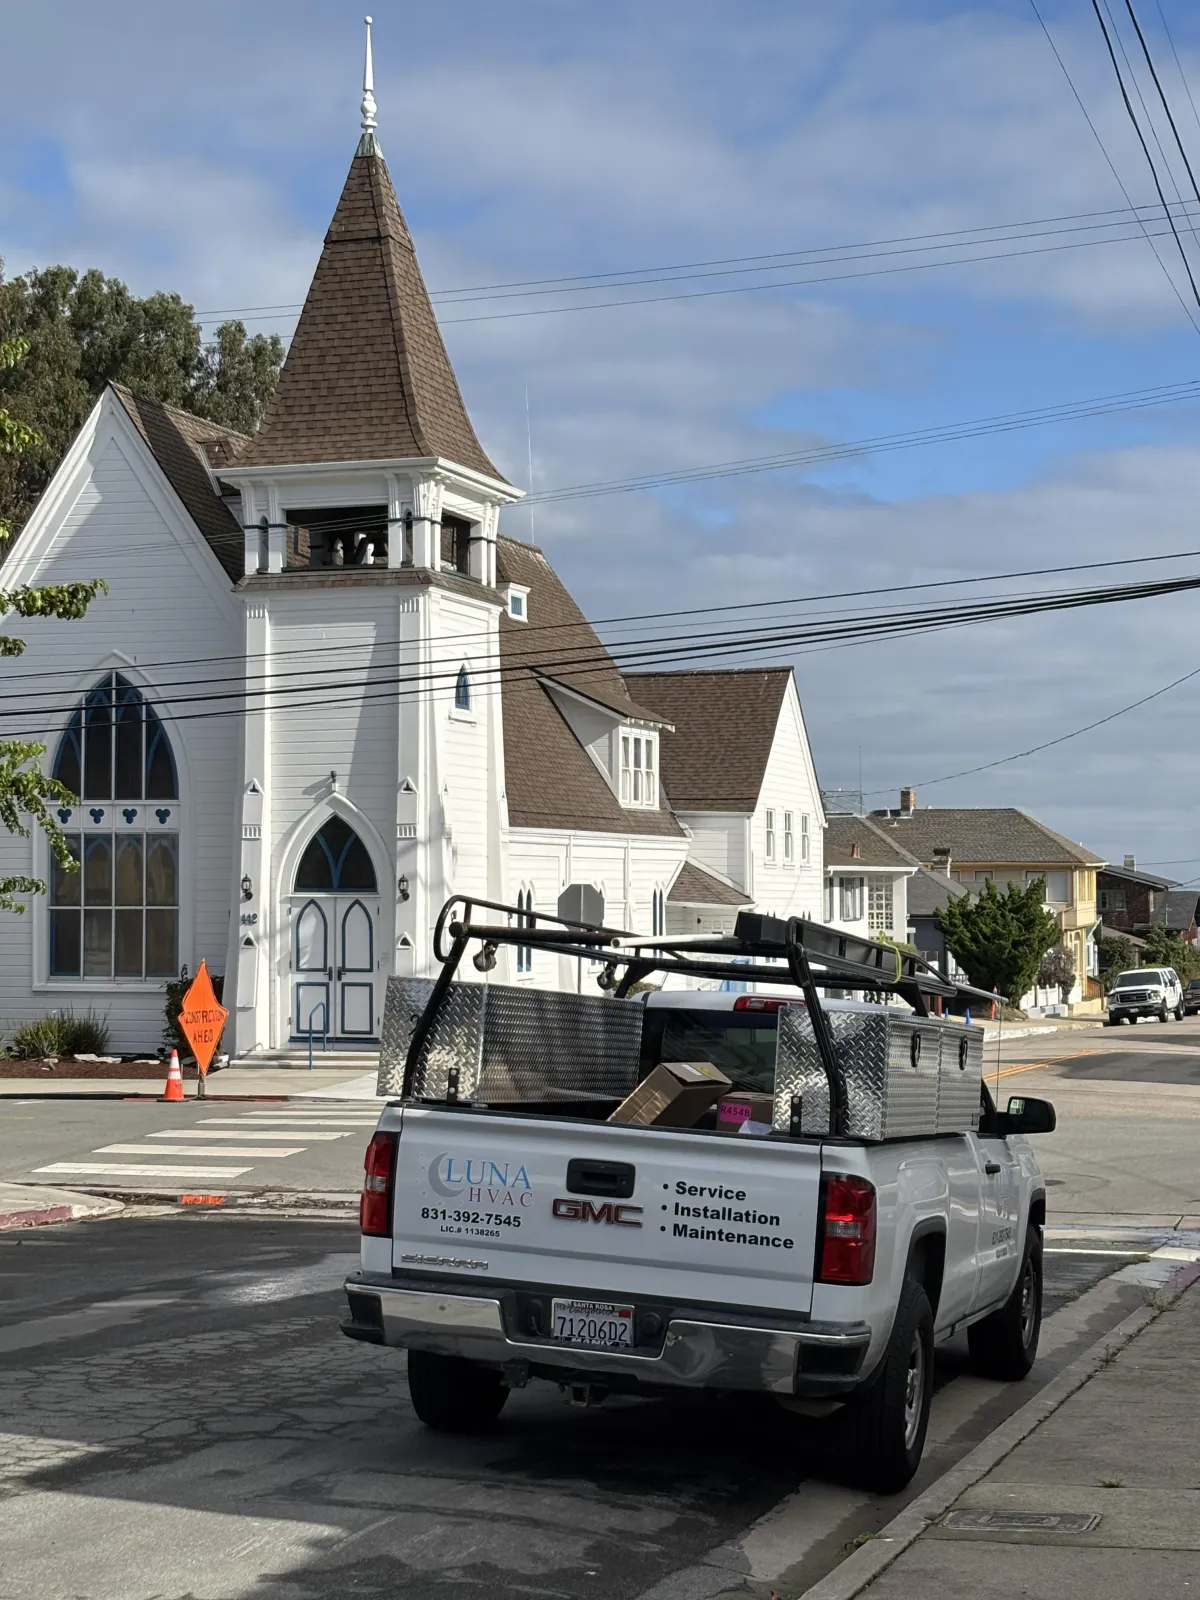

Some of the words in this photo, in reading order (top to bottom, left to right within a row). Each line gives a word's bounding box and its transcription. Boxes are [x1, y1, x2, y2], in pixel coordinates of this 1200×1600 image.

[192, 1029, 214, 1044] AHED
[720, 1105, 750, 1117] R454B
[445, 1157, 532, 1189] LUNA
[468, 1187, 533, 1208] HVAC
[675, 1180, 747, 1201] Service
[421, 1207, 522, 1228] 831-392-7545
[552, 1197, 645, 1229] GMC
[674, 1201, 781, 1226] Installation
[440, 1225, 462, 1234] LIC.#
[464, 1227, 501, 1238] 1138265
[672, 1223, 795, 1249] Maintenance
[401, 1253, 489, 1270] SIERRA
[572, 1301, 594, 1309] SANTA
[594, 1303, 613, 1311] ROSA
[557, 1315, 628, 1342] 71206D2
